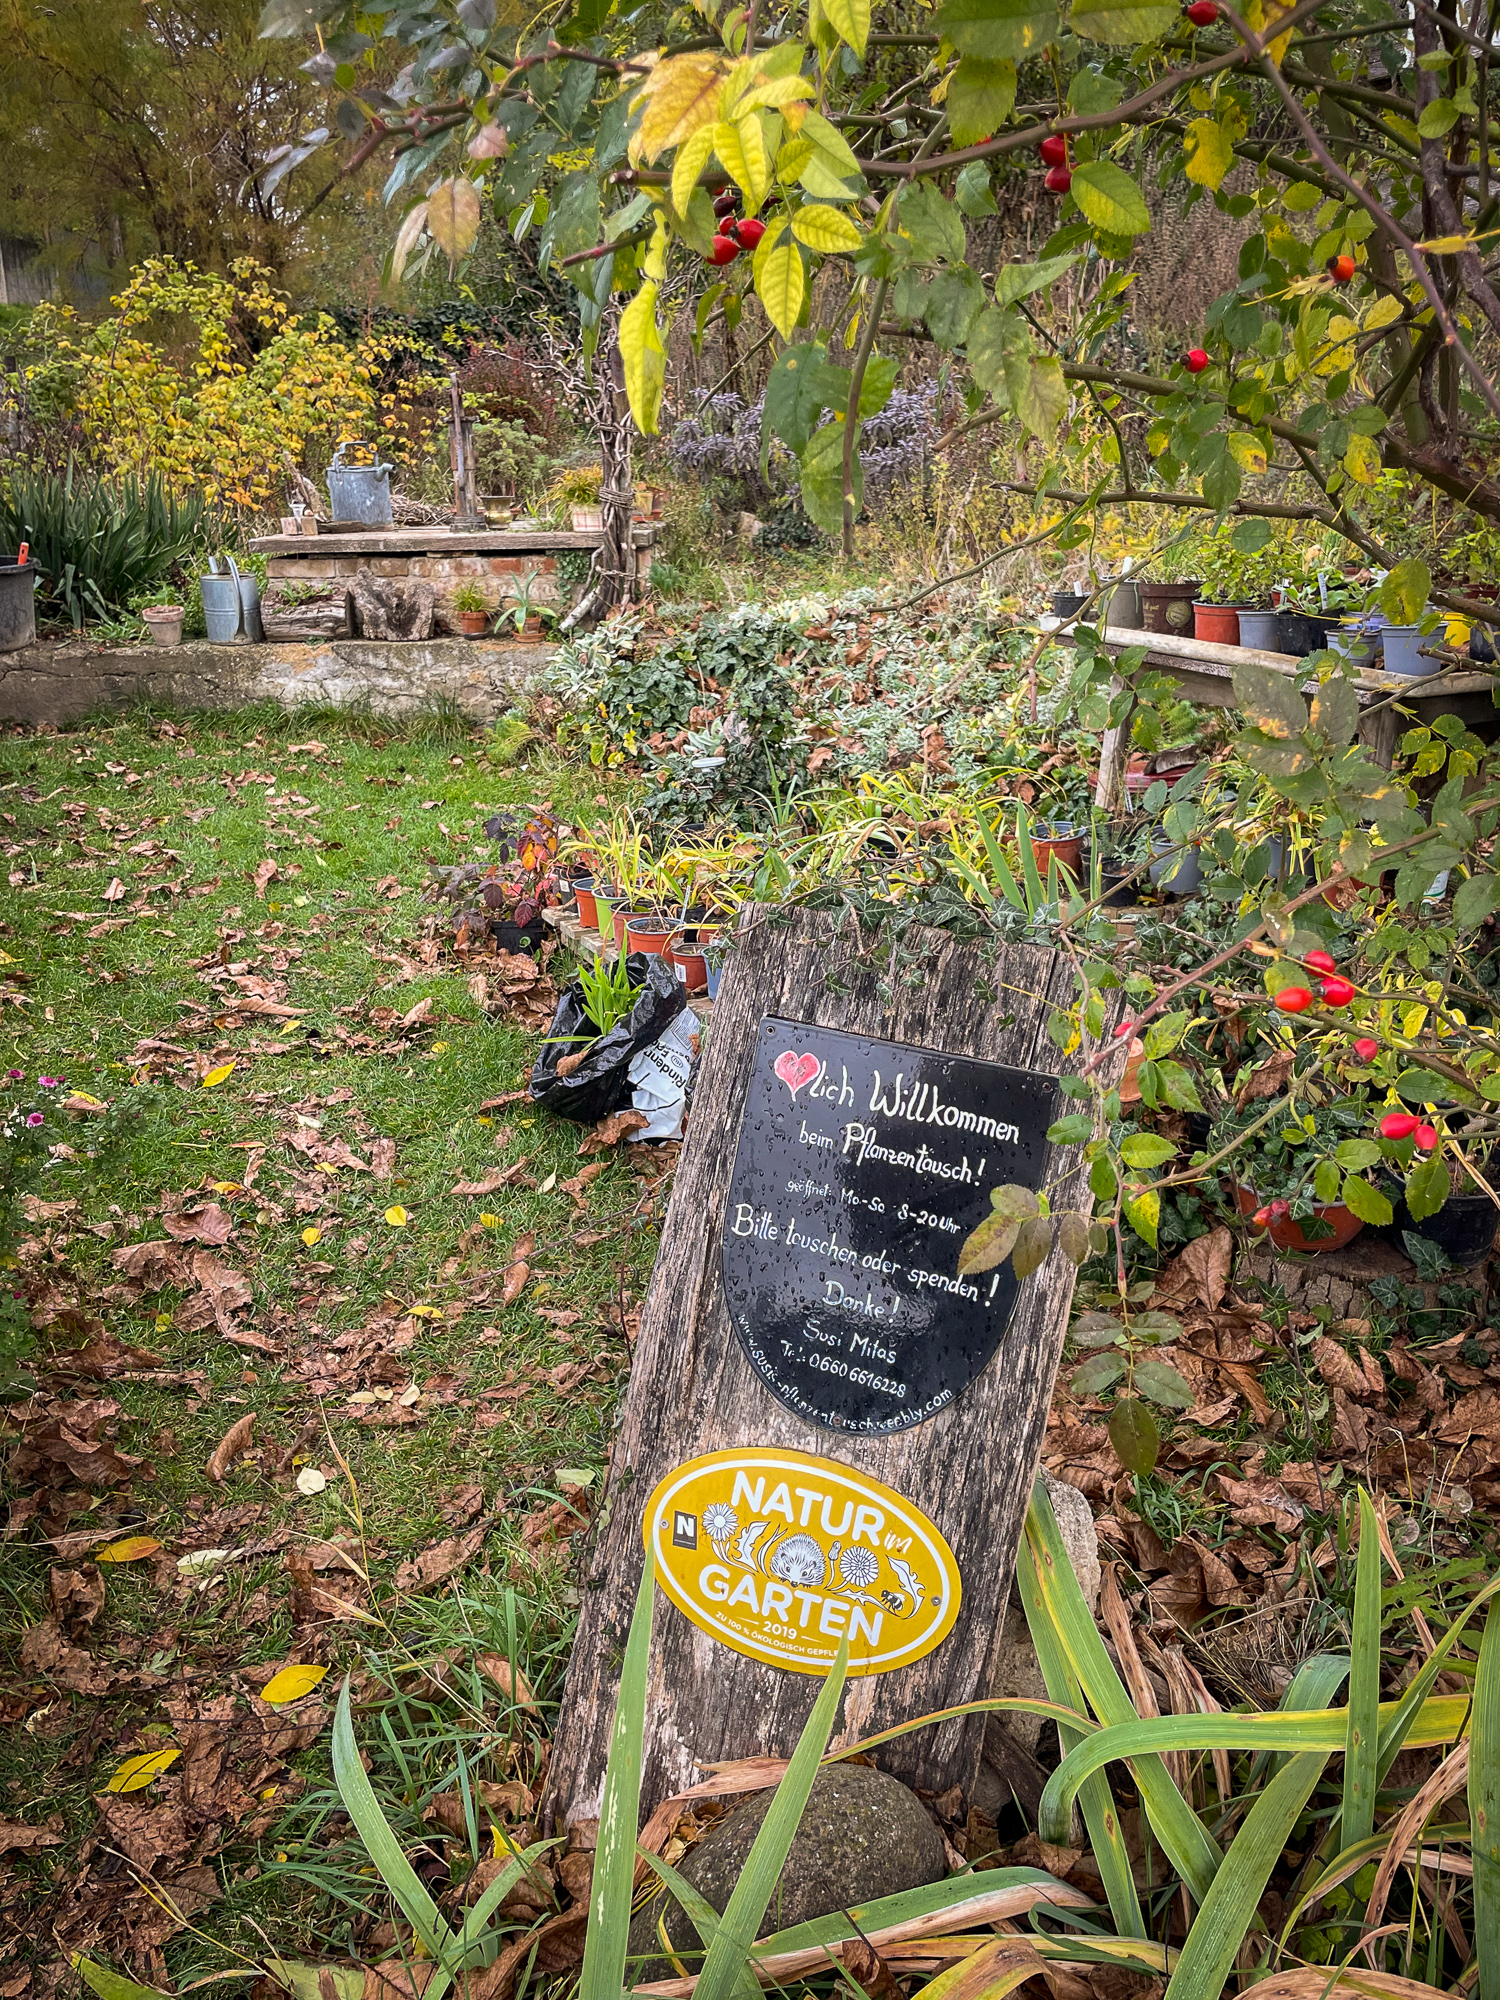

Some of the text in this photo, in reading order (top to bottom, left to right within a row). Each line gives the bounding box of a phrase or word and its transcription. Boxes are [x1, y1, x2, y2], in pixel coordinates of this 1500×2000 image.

[809, 1060, 1019, 1144] lich Willkommen
[798, 1120, 834, 1149] beim
[731, 1203, 778, 1241] Bitte
[862, 1249, 901, 1276] oder
[802, 1319, 897, 1364] Susi Mitas
[677, 1515, 694, 1537] N
[731, 1470, 913, 1555] NATUR im
[699, 1564, 883, 1647] GARTEN
[715, 1611, 727, 1621] ZU
[728, 1618, 741, 1631] 100
[751, 1630, 805, 1653] ÖKOLOGISCH
[807, 1648, 840, 1657] GEPFLE
[762, 1620, 797, 1641] 2019
